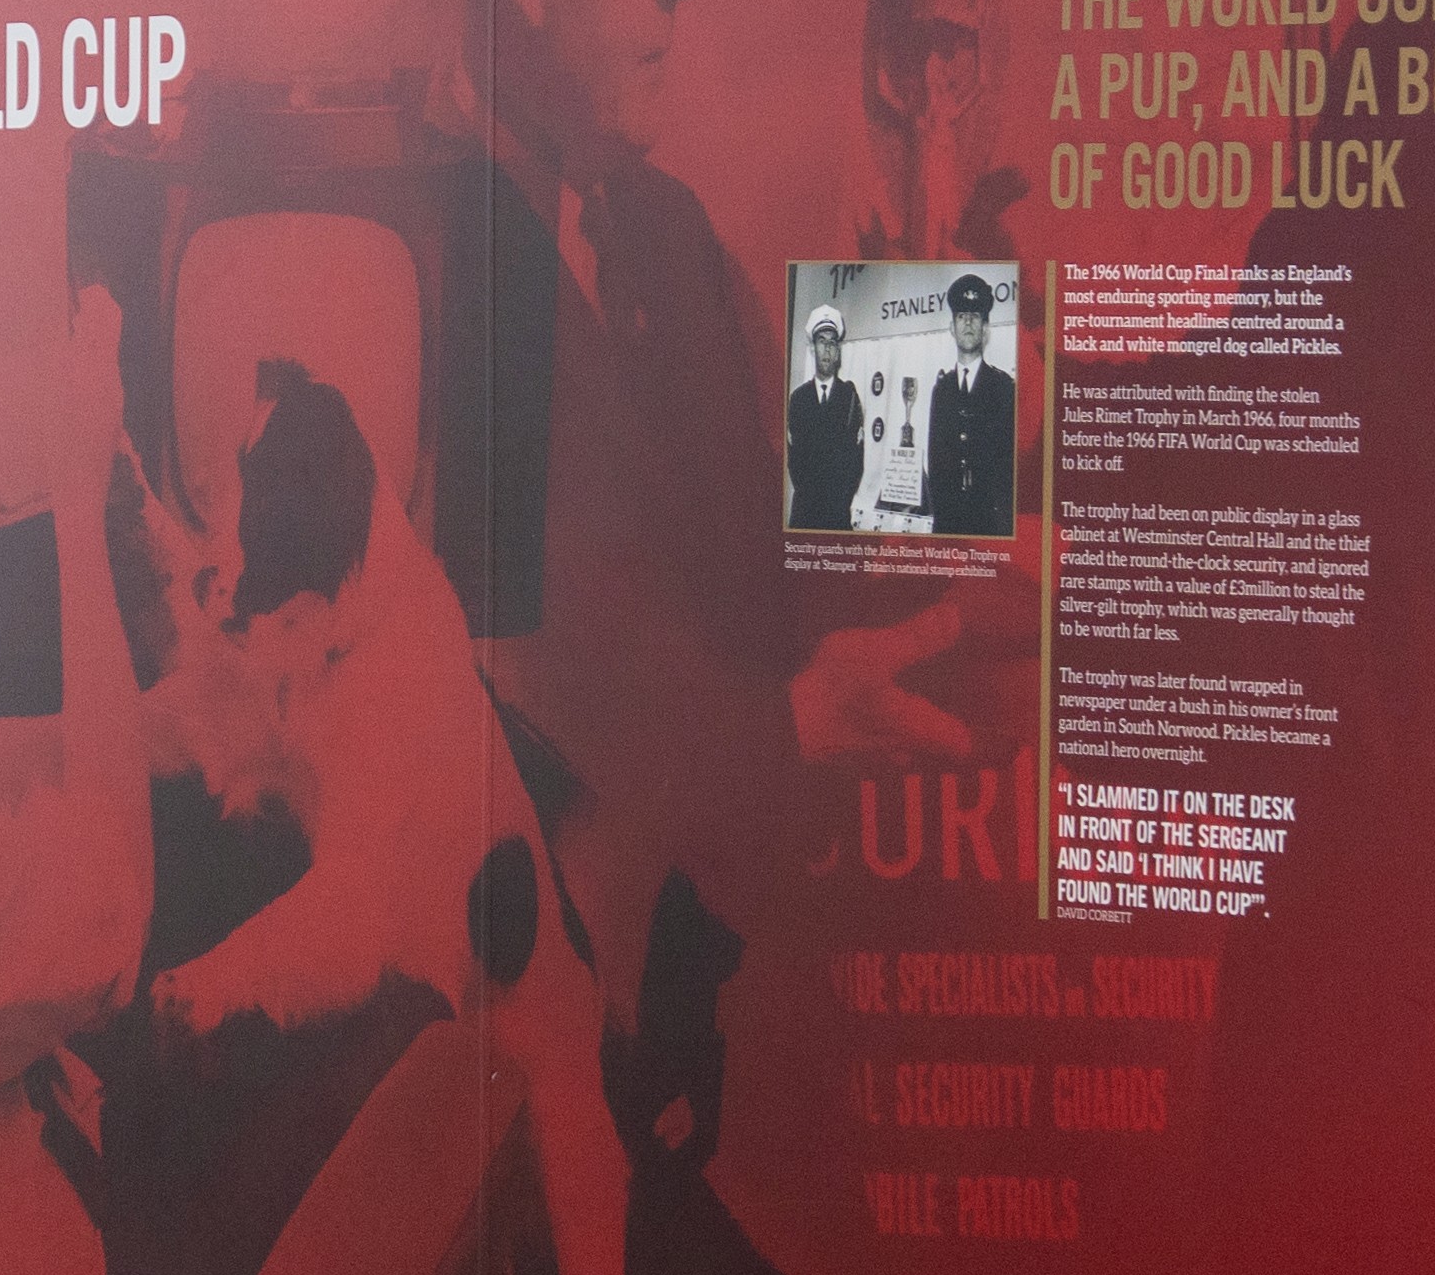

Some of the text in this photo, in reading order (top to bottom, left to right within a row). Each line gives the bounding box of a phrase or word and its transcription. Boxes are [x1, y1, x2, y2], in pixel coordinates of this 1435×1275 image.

[62, 15, 186, 129] CUP
[1051, 54, 1081, 121] A
[1099, 51, 1203, 130] PUP,
[1223, 47, 1327, 117] AND
[1344, 48, 1379, 115] A
[1050, 141, 1405, 209] OF GOOD LUCK
[1064, 264, 1089, 279] The
[1091, 264, 1120, 280] 1966
[1123, 264, 1163, 280] World
[1165, 264, 1192, 283] Cup
[1194, 264, 1228, 280] Final
[1231, 264, 1268, 281] ranks
[1271, 269, 1285, 281] as
[881, 293, 946, 320] STANLEY
[1064, 290, 1094, 303] most
[1097, 288, 1155, 307] enduring
[1157, 289, 1211, 308] sporting
[1274, 289, 1297, 305] but
[1300, 289, 1323, 305] the
[1063, 312, 1343, 330] pre-tournament headlines centred around a
[1063, 335, 1097, 351] black
[1099, 336, 1123, 351] and
[1126, 336, 1164, 352] white
[1167, 337, 1221, 356] mongrel
[1223, 337, 1247, 357] dog
[1249, 337, 1289, 354] called
[1063, 383, 1319, 405] He was attributed with finding the stolen
[1063, 406, 1093, 422] Jules
[1095, 407, 1132, 423] Rimet
[1134, 408, 1180, 427] Trophy
[1183, 409, 1195, 425] in
[1199, 409, 1240, 426] March
[1279, 411, 1306, 427] four
[1309, 412, 1359, 428] months
[1062, 430, 1359, 454] before the 1966 FIFA World Cup was scheduled
[1061, 455, 1074, 469] to
[1077, 454, 1102, 470] kick
[1061, 501, 1360, 529] The trophy had been on public display in a glass
[1059, 667, 1303, 697] The trophy was later found wrapped in
[1059, 695, 1126, 712] newspaper
[1129, 695, 1166, 712] under
[1169, 701, 1176, 712] a
[1179, 697, 1210, 714] bush
[1213, 699, 1226, 715] in
[1229, 699, 1248, 716] his
[1304, 704, 1337, 722] front
[1058, 715, 1101, 733] garden
[1103, 717, 1116, 733] in
[1119, 717, 1155, 735] South
[1223, 723, 1267, 742] Pickles
[1270, 726, 1320, 745] became
[1322, 734, 1330, 746] a
[1059, 739, 1108, 756] national
[1111, 741, 1139, 758] hero
[1077, 784, 1158, 811] SLAMMED
[1163, 789, 1179, 812] IT
[1183, 791, 1207, 815] ON
[1212, 792, 1244, 817] THE
[1250, 795, 1294, 821] DESK
[1059, 814, 1287, 852] IN FRONT OF THE SERGEANT
[1057, 847, 1091, 871] AND
[1096, 849, 1133, 874] SAID
[1153, 853, 1203, 880] THINK
[1209, 857, 1213, 880] I
[1219, 858, 1263, 884] HAVE
[1058, 878, 1111, 906] FOUND
[1115, 883, 1147, 908] THE
[1152, 886, 1211, 913] WORLD
[1057, 908, 1132, 923] DAVID CORBETT
